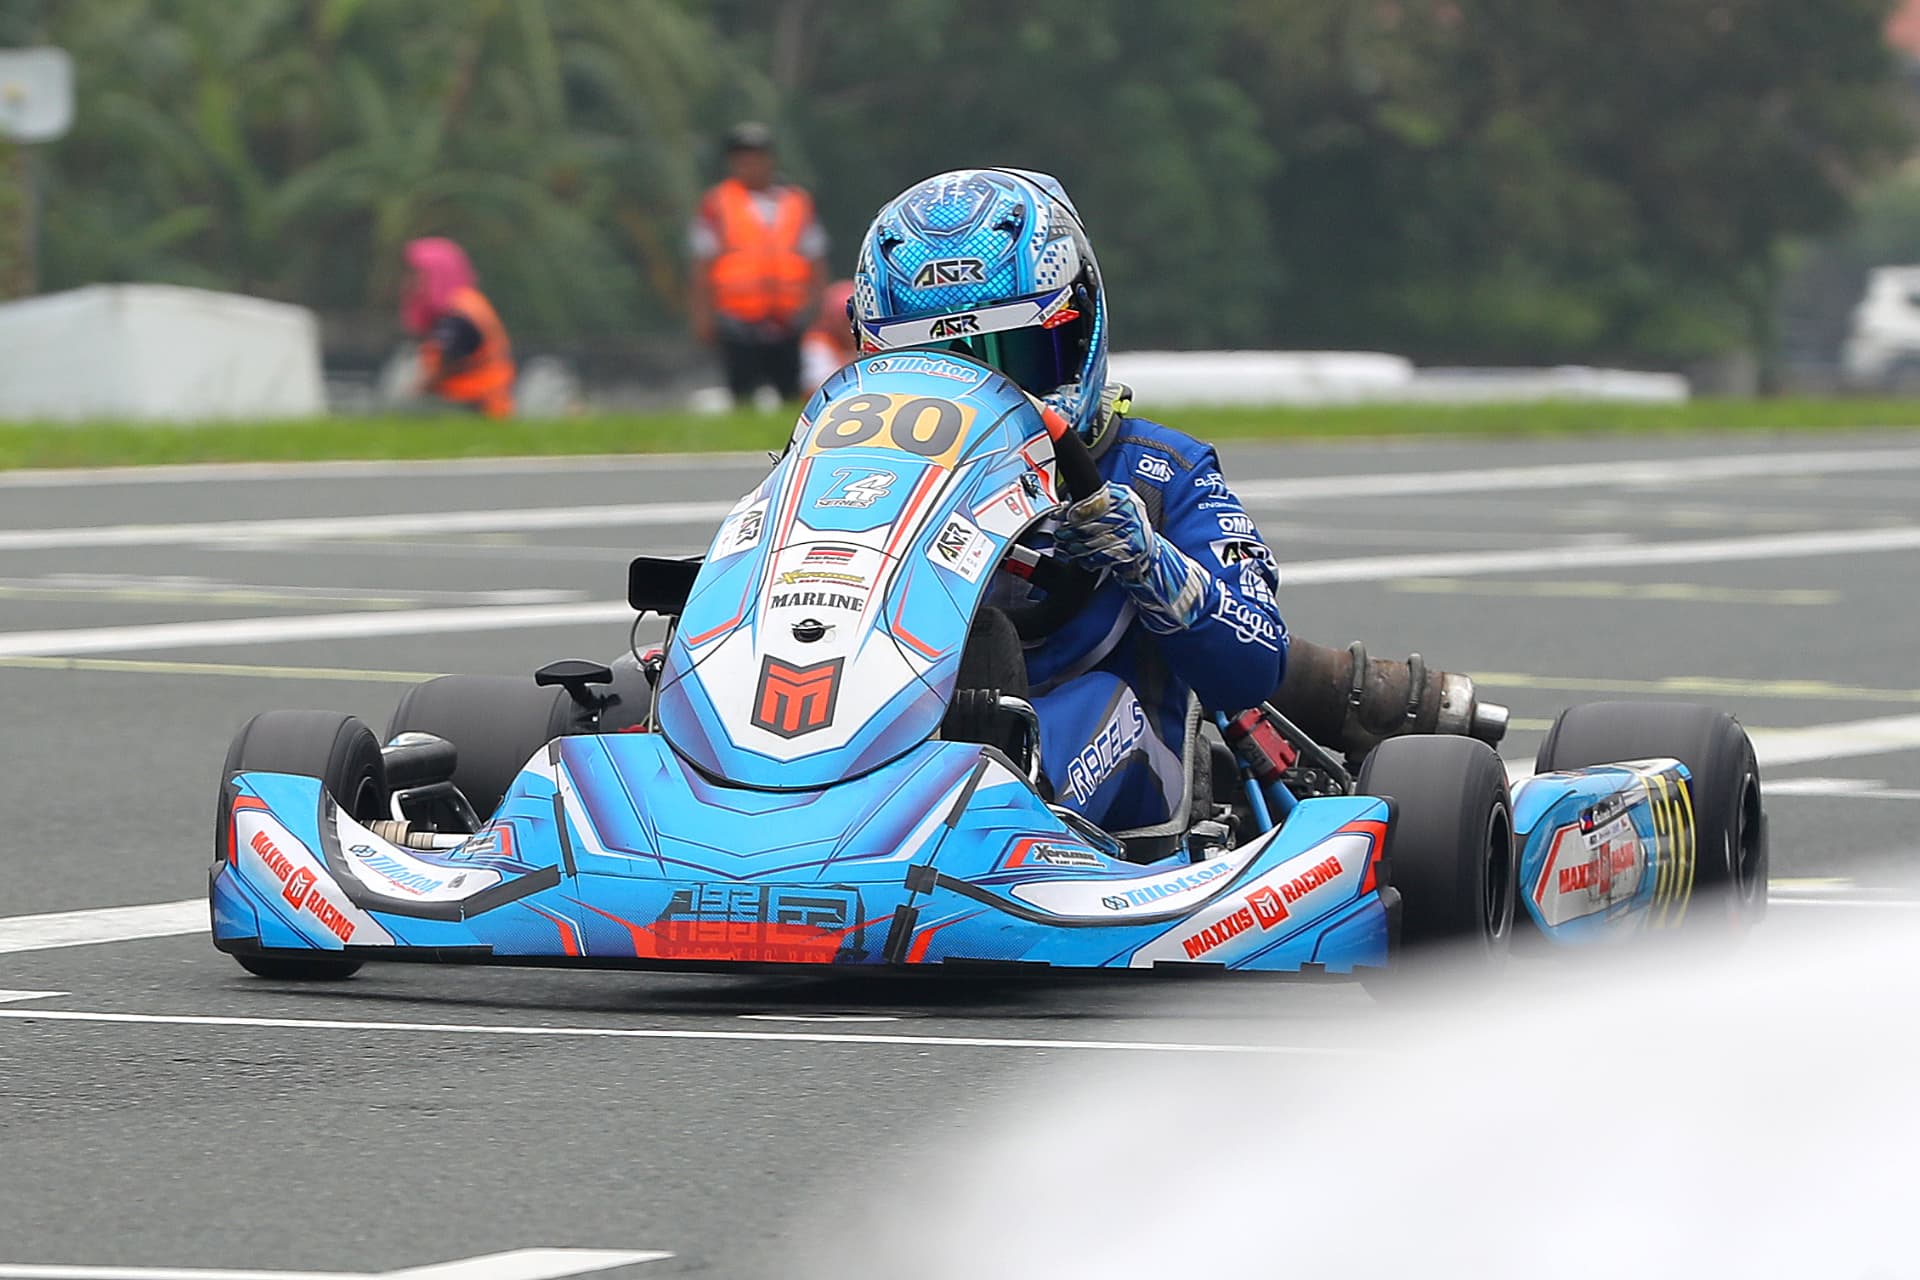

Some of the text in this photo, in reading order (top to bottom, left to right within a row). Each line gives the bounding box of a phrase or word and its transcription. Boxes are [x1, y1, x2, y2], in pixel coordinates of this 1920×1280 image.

[914, 260, 985, 288] AGR
[929, 315, 980, 340] AGR
[815, 394, 961, 455] 80
[1218, 517, 1254, 533] OMP
[770, 592, 864, 612] MARLINE
[250, 830, 295, 882] MAXXIS
[305, 889, 356, 943] RACING
[1122, 862, 1229, 906] Tillotson
[1182, 907, 1255, 960] MAXXIS
[1279, 856, 1343, 904] RACING
